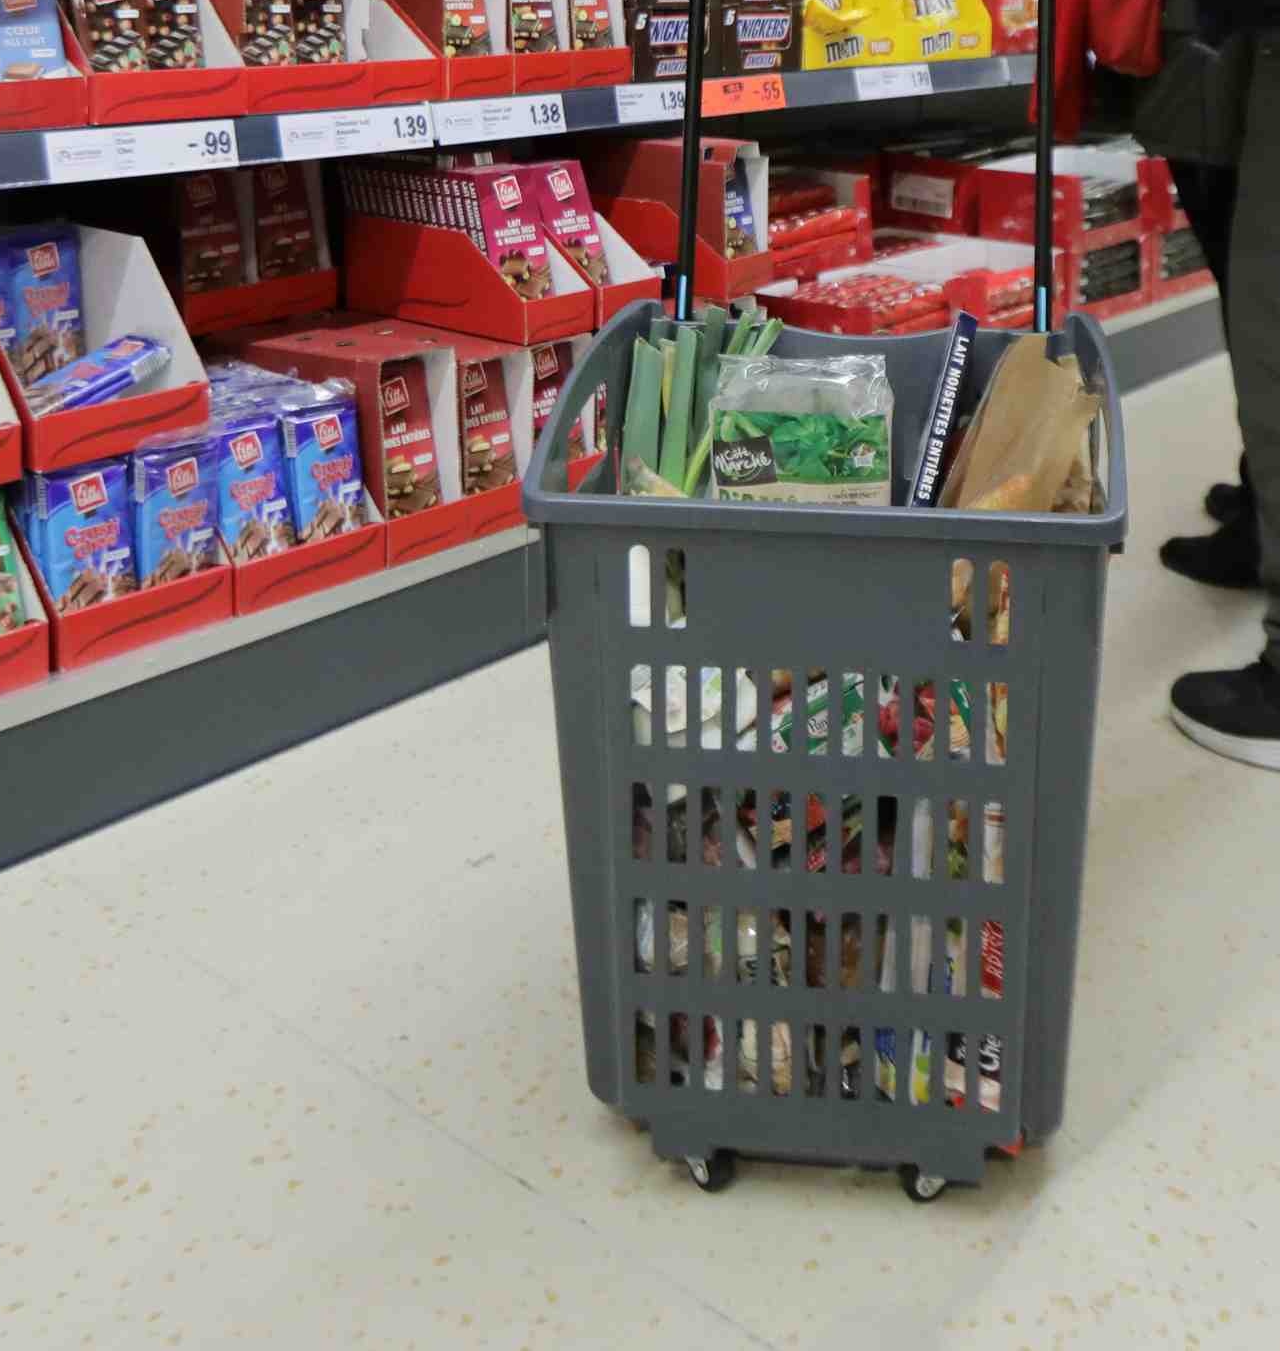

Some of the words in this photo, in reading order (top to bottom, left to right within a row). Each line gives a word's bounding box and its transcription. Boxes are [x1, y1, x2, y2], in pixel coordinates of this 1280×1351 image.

[737, 19, 788, 42] SNICKERS
[660, 91, 685, 111] 1.39
[530, 103, 561, 125] 1.38
[394, 115, 427, 139] 1.39
[187, 131, 232, 157] -.99
[952, 335, 969, 366] LAIT
[933, 367, 961, 437] NOISETTES
[919, 437, 944, 501] ENTIÈRES
